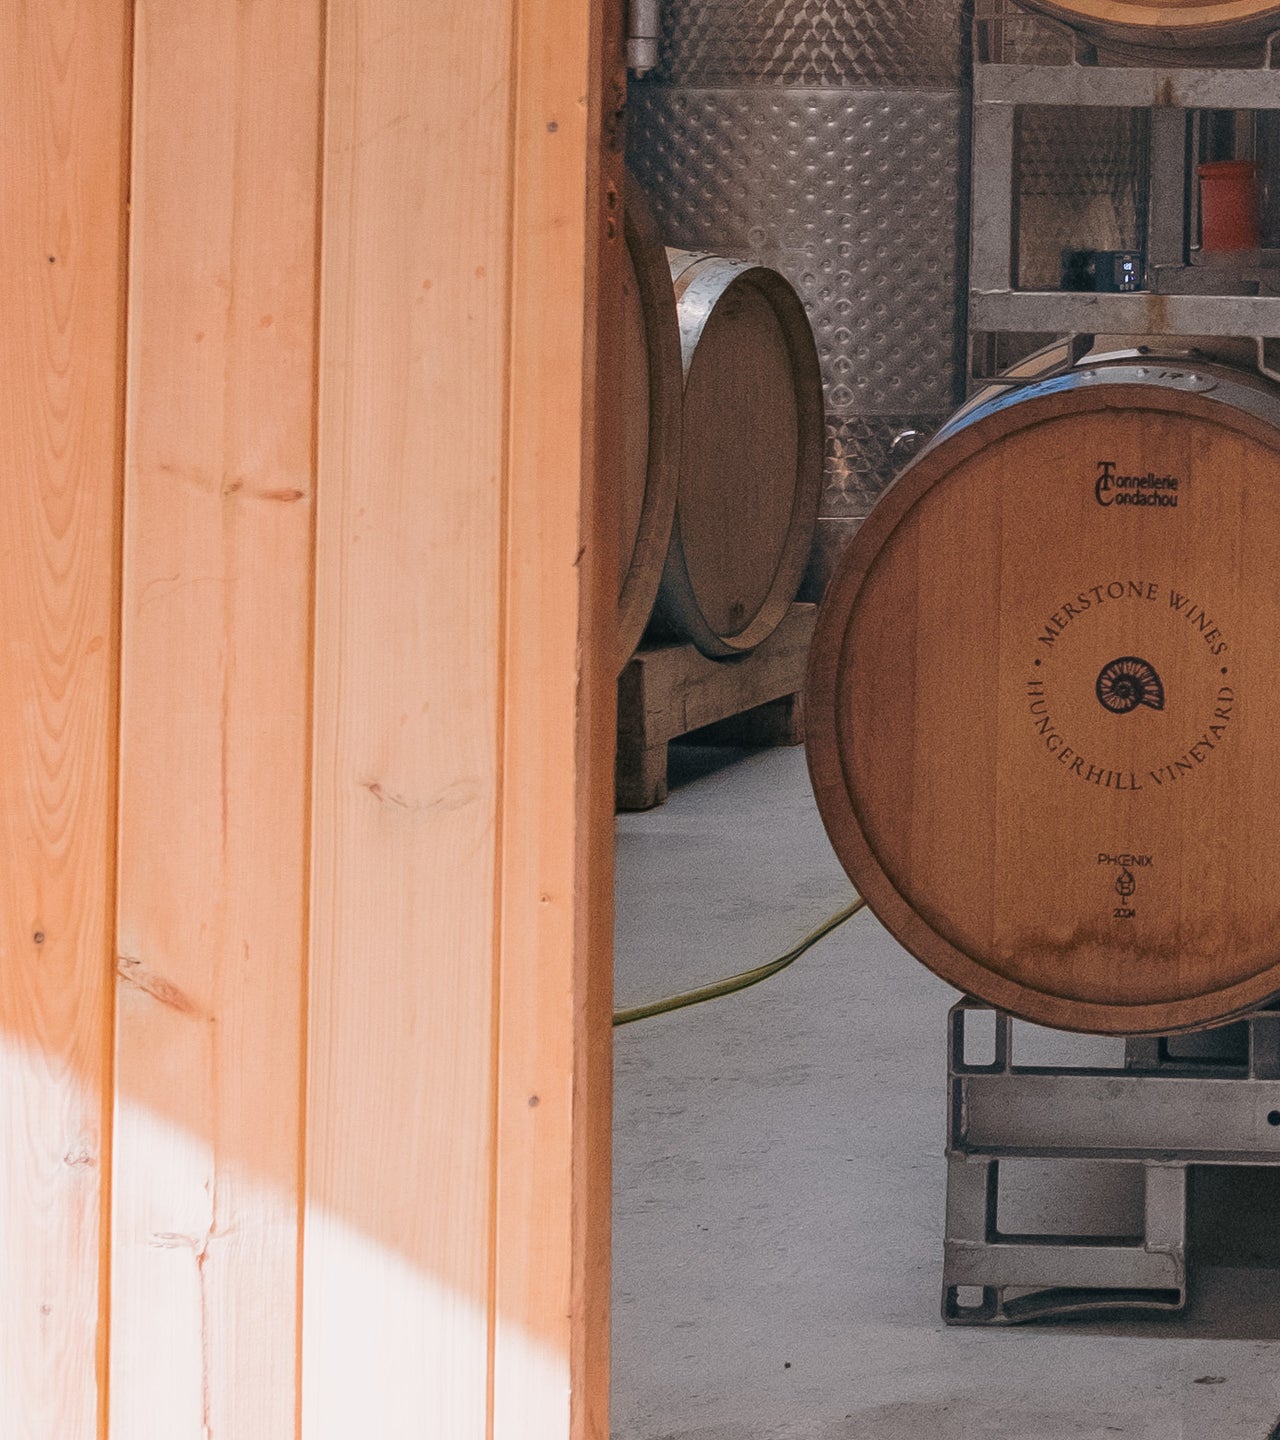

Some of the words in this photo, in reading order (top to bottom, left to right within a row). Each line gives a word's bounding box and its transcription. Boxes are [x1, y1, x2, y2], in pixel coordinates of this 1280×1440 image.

[1094, 474, 1179, 507] Condachou
[1096, 461, 1179, 491] Tonnellerie
[1038, 580, 1160, 649] MERSTONE
[1169, 589, 1228, 656] WINES
[1027, 681, 1144, 791] HUNGERHILL
[1150, 686, 1235, 785] VINEYARD
